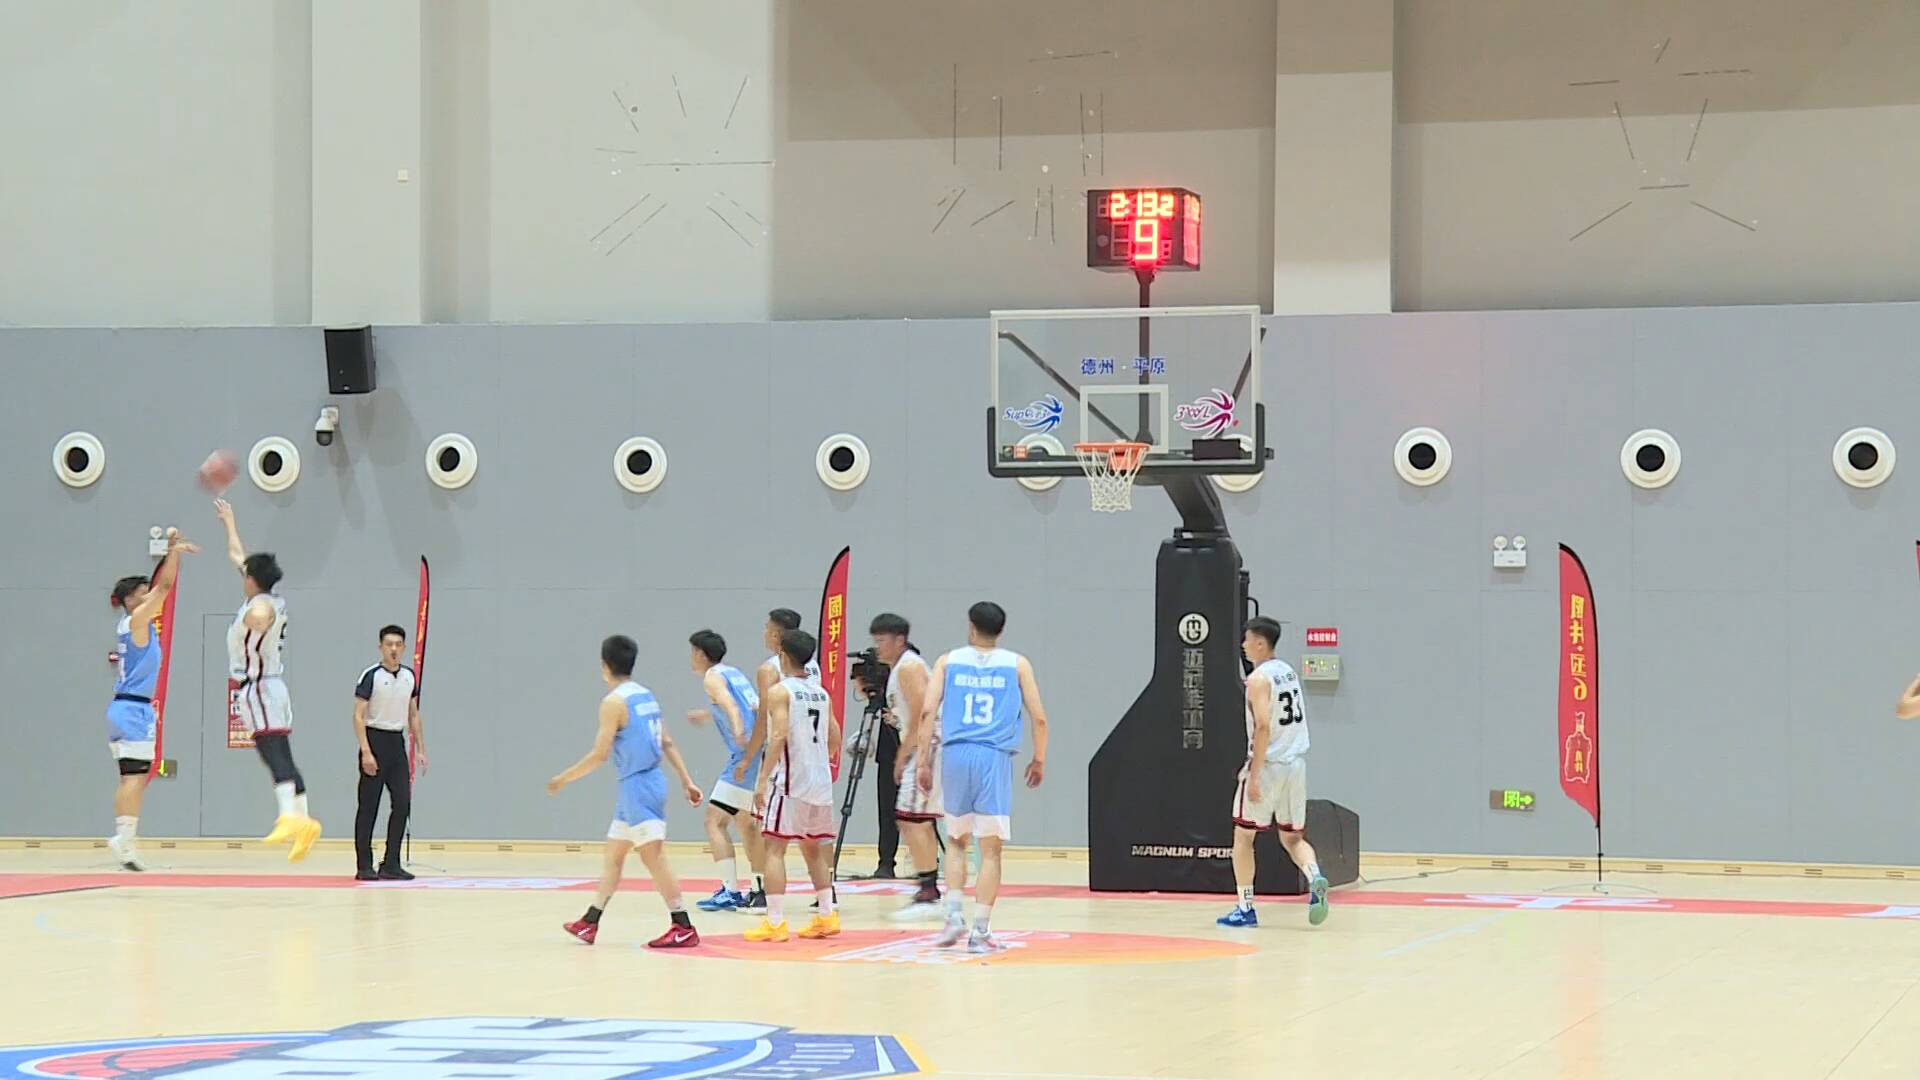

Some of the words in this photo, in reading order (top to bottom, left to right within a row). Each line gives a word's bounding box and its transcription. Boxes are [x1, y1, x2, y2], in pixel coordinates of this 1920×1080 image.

[1134, 219, 1158, 260] 9
[807, 708, 820, 743] 7
[961, 692, 995, 725] 13
[1131, 845, 1194, 858] MAGNUM
